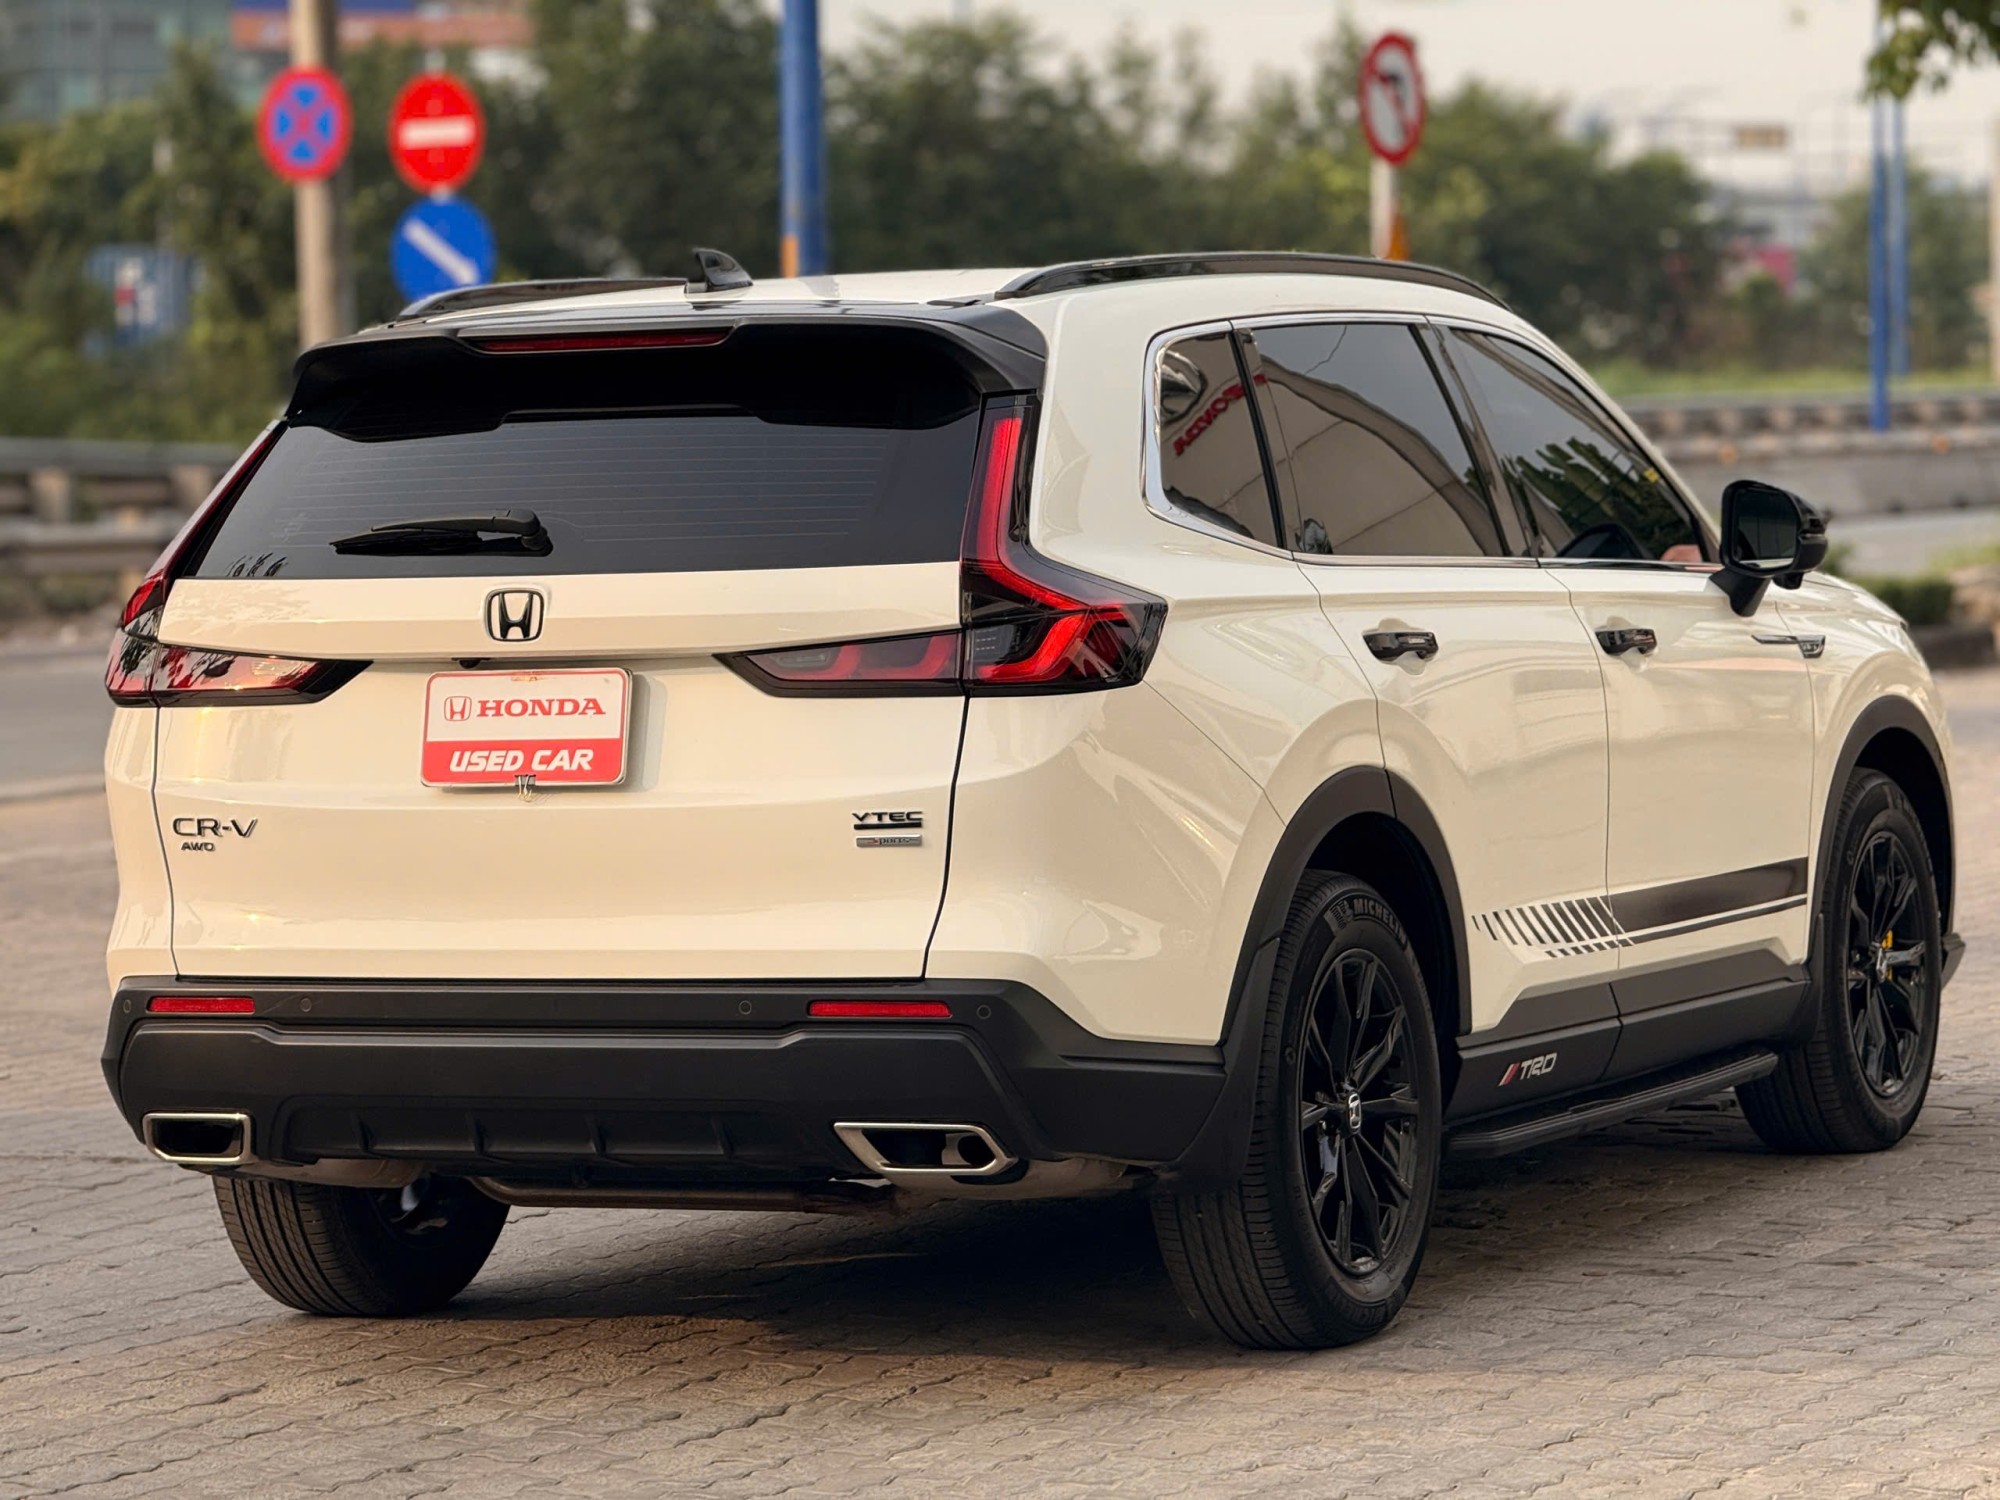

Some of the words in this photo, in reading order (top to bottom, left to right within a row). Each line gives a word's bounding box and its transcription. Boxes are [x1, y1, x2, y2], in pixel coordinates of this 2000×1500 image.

[476, 697, 606, 718] HONDA
[449, 750, 524, 772] USED
[531, 749, 594, 771] CAR
[851, 811, 923, 822] VTEC
[172, 817, 258, 838] CR-V
[181, 842, 216, 852] AWD
[1520, 1052, 1558, 1080] TRD
